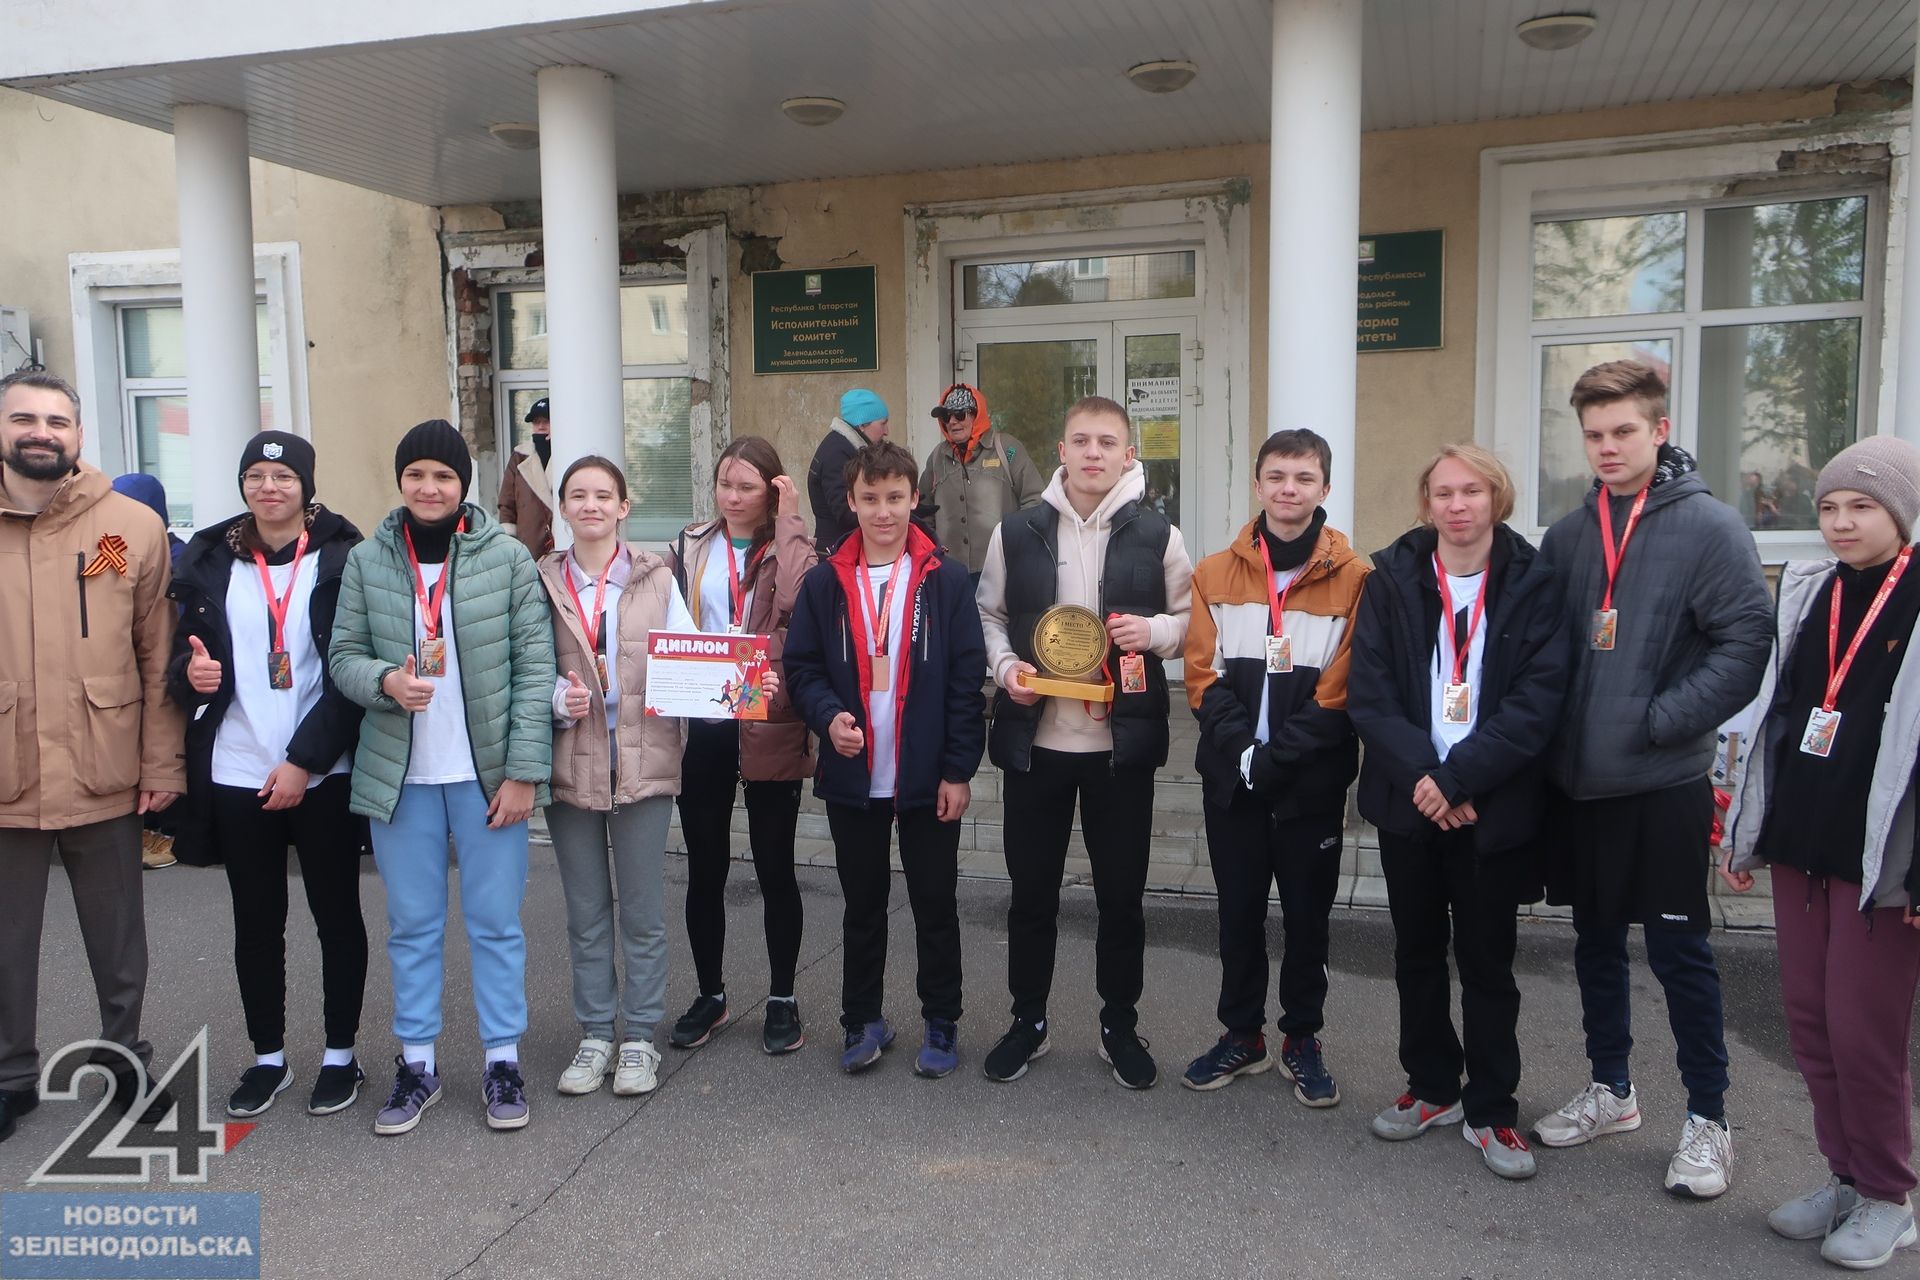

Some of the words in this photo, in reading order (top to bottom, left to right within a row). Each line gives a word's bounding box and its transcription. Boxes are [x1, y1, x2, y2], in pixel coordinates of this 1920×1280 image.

[771, 304, 815, 312] Республика
[818, 302, 858, 311] Татарстан
[771, 316, 858, 330] Исполнительный
[1357, 318, 1399, 328] карма
[793, 332, 837, 342] комитет
[784, 348, 844, 357] Зеленодольского
[830, 356, 858, 364] района
[654, 638, 729, 654] ДИПЛОМ
